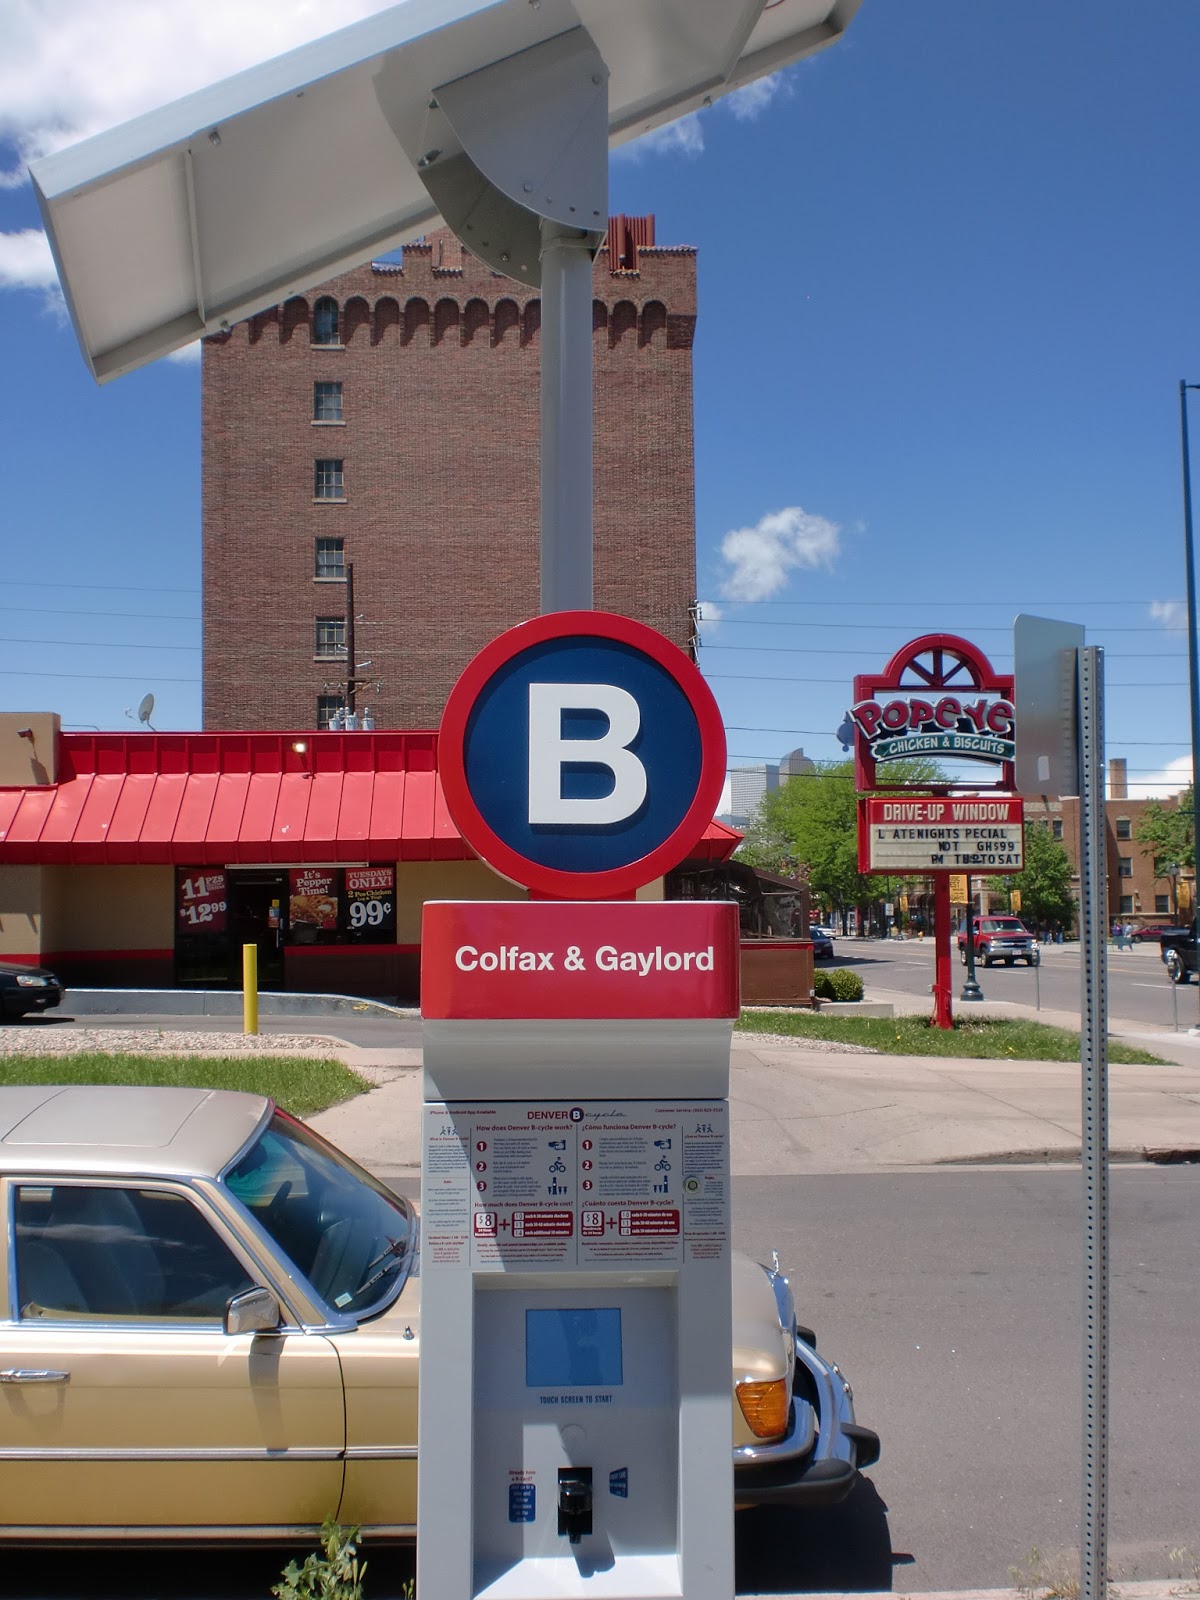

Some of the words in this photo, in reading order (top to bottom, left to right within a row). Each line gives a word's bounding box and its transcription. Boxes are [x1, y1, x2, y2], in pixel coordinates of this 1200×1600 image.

[849, 696, 1015, 740] POPEYE
[889, 738, 939, 754] CHICKEN
[942, 736, 951, 747] &
[954, 736, 1005, 754] BISCUITS
[528, 682, 648, 825] B
[883, 803, 945, 821] DRIVE-UP
[952, 803, 1010, 821] WINDOW
[303, 870, 321, 880] It's
[347, 869, 392, 879] TUESDAYS
[296, 878, 333, 888] Pepper
[349, 876, 392, 889] ONLY!
[181, 876, 210, 900] 11
[298, 885, 329, 896] Time!
[347, 890, 355, 898] 2
[454, 945, 555, 972] Colfax
[563, 945, 587, 972] &
[595, 945, 715, 977] Gaylord
[527, 1110, 569, 1120] DENVER
[531, 1124, 553, 1132] B-cycle
[652, 1123, 677, 1131] B-cycle?
[478, 1162, 484, 1171] 2
[584, 1161, 590, 1170] 2
[479, 1182, 485, 1191] 3
[585, 1181, 591, 1190] 3
[650, 1199, 674, 1207] B-cycle?
[540, 1395, 559, 1405] TOUCH
[560, 1395, 584, 1405] SCREEN
[585, 1395, 593, 1404] TO
[594, 1394, 612, 1403] START
